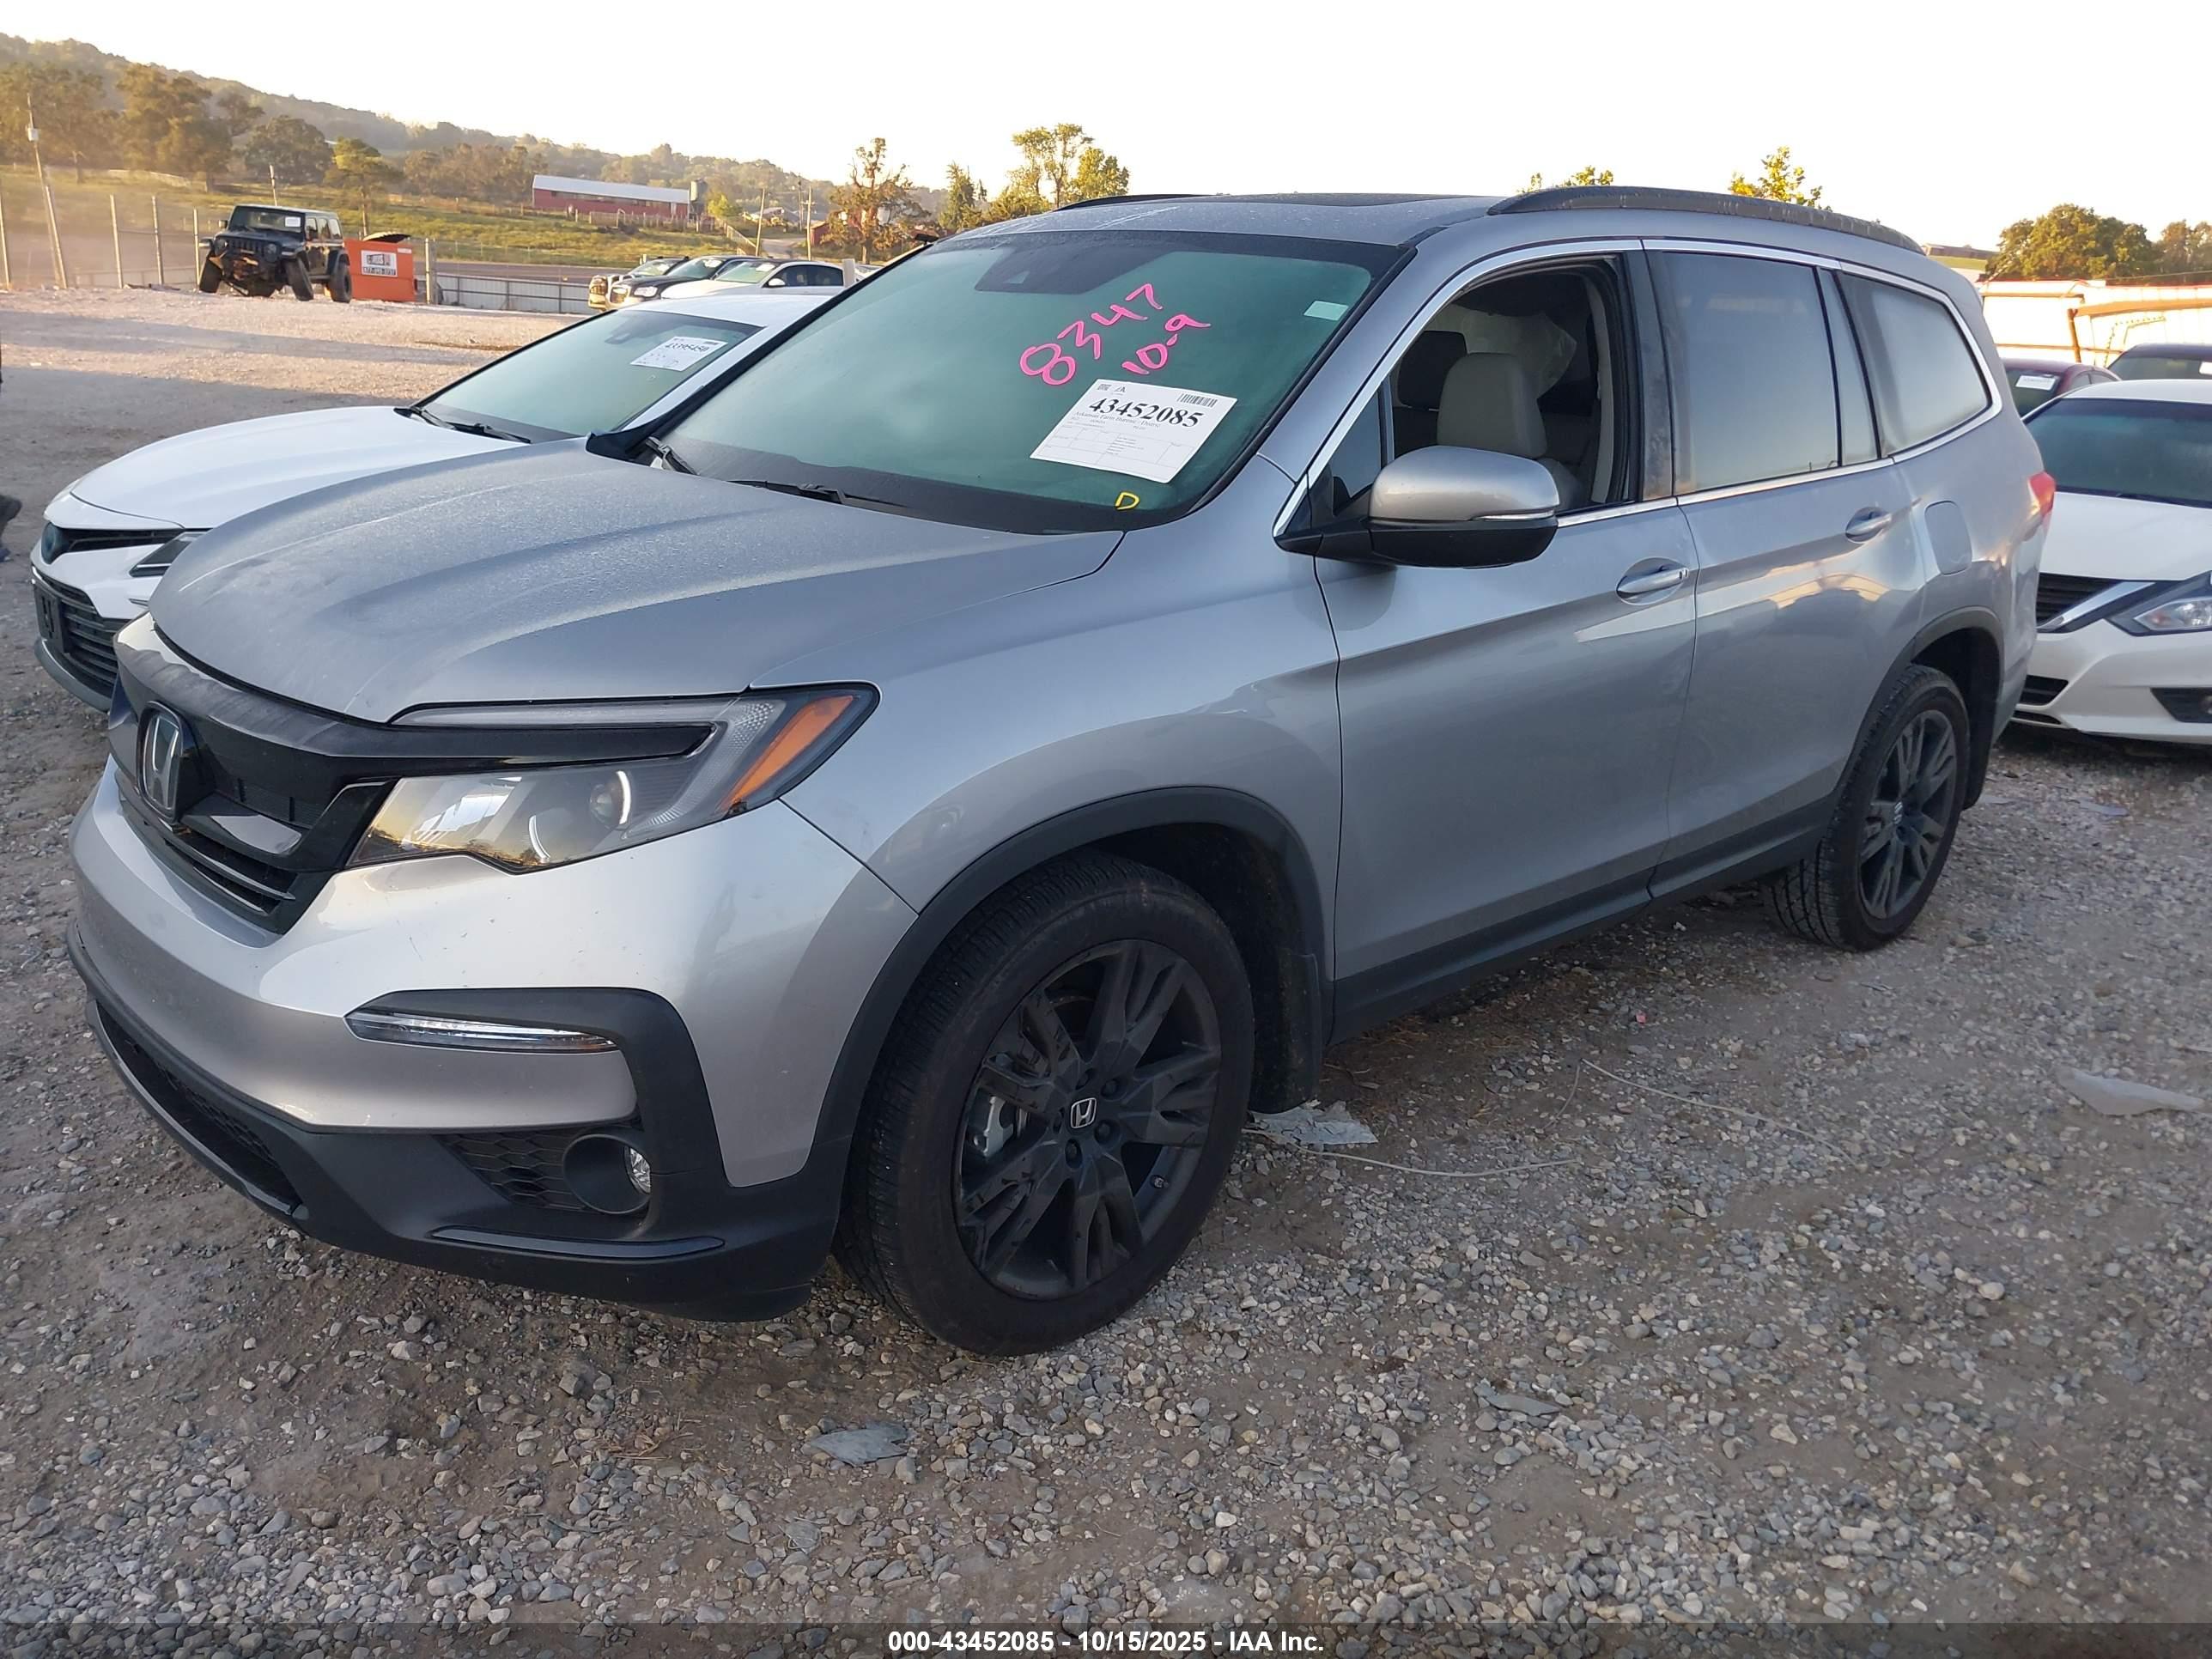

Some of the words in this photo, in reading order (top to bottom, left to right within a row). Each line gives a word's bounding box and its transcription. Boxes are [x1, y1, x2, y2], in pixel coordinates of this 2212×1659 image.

[1019, 283, 1164, 386] 8347
[1121, 313, 1212, 375] 10-9
[1089, 397, 1203, 428] 43452085
[1115, 491, 1139, 511] D
